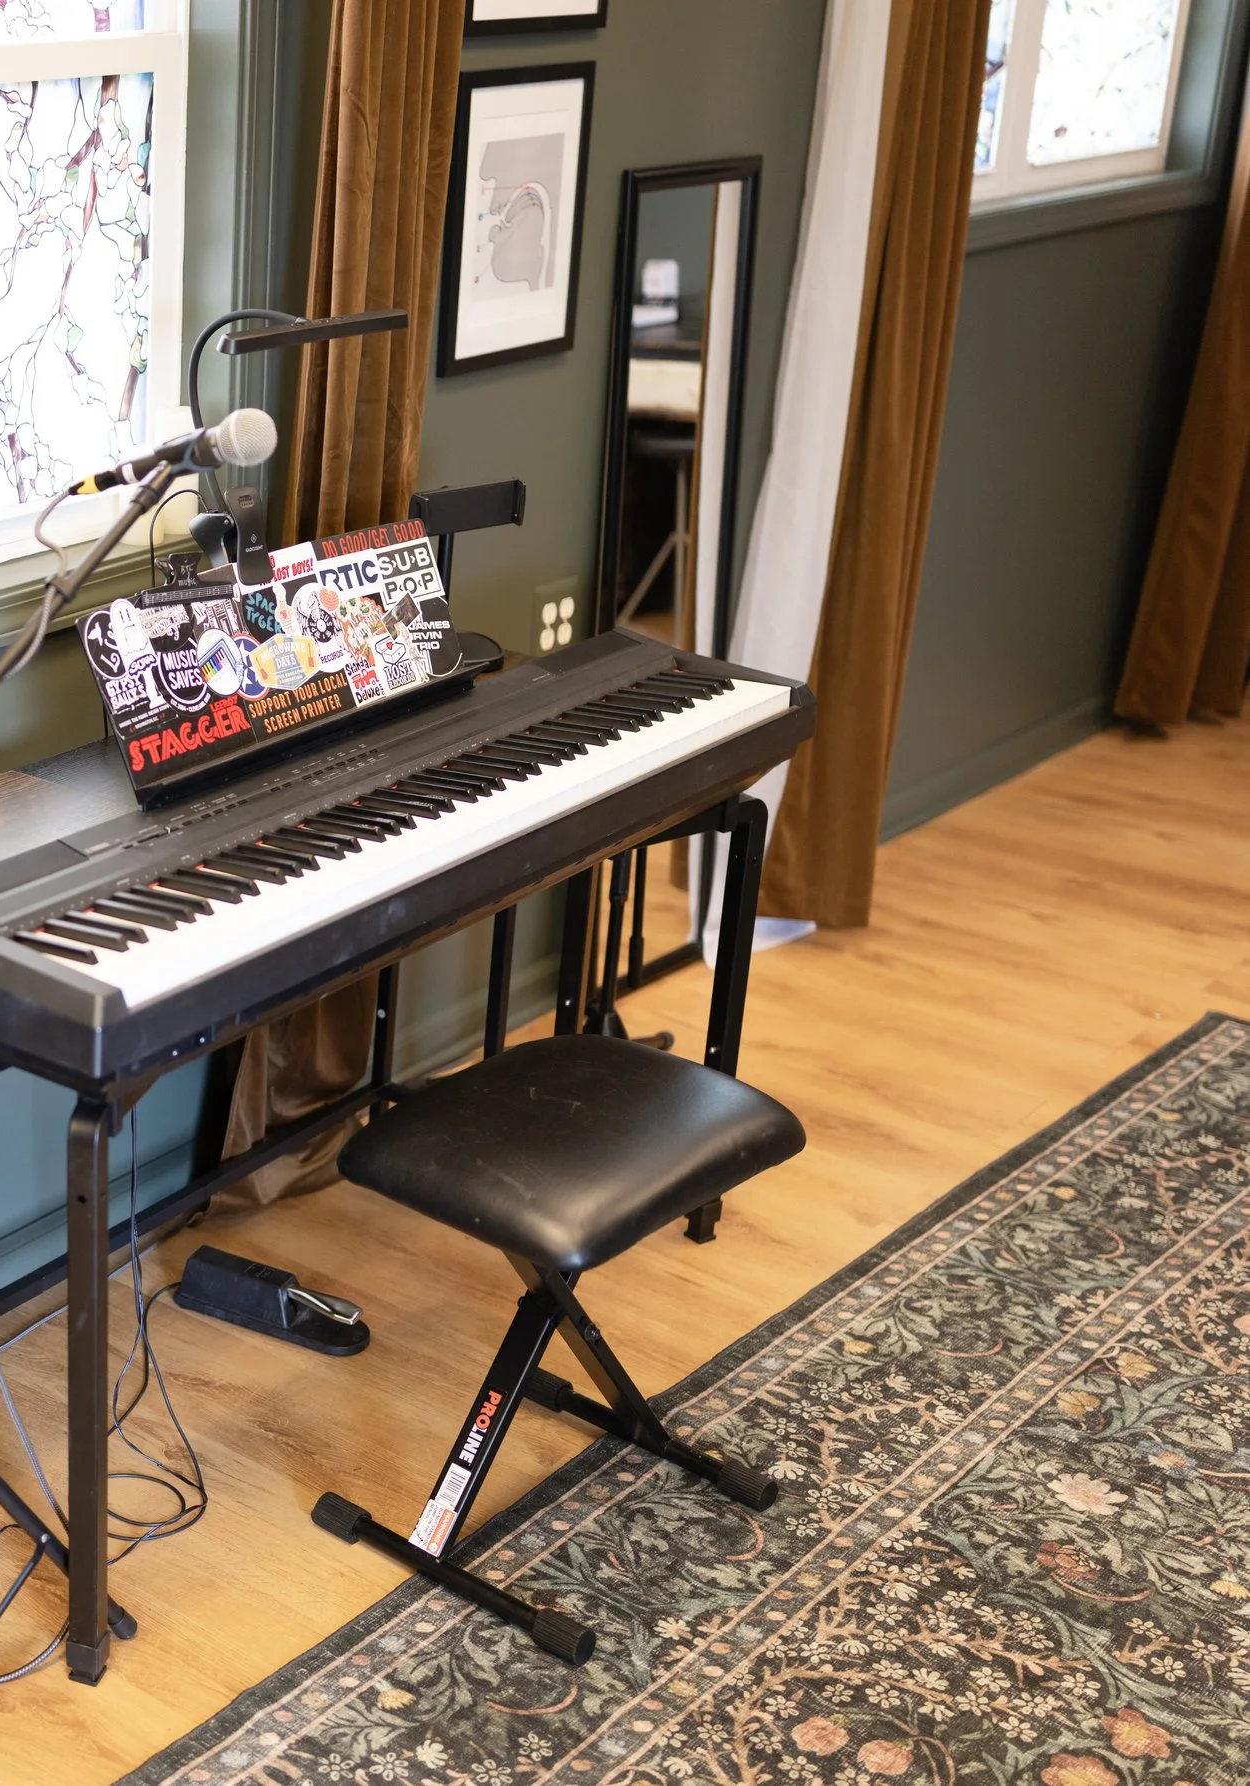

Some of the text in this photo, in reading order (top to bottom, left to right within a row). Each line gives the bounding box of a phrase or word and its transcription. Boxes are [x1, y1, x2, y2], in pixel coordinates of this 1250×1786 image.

[322, 540, 338, 558] DO
[393, 520, 424, 542] GOOD
[273, 565, 289, 581] LOST
[291, 558, 314, 577] BOYS!
[319, 560, 378, 591] RTIC
[246, 592, 275, 614] SPAC
[409, 621, 451, 631] JAMES
[162, 649, 197, 670] MUSIC
[276, 654, 297, 669] DAVE
[320, 650, 344, 664] RECORDS
[168, 667, 203, 690] SAVES
[384, 661, 413, 681] LOST
[248, 673, 348, 719] SUPPORT YOUR LOCAL
[355, 686, 381, 704] Deluxe
[264, 694, 342, 734] SCREEN PRINTER
[128, 705, 251, 772] STAGGER
[459, 1391, 503, 1464] PROLINE
